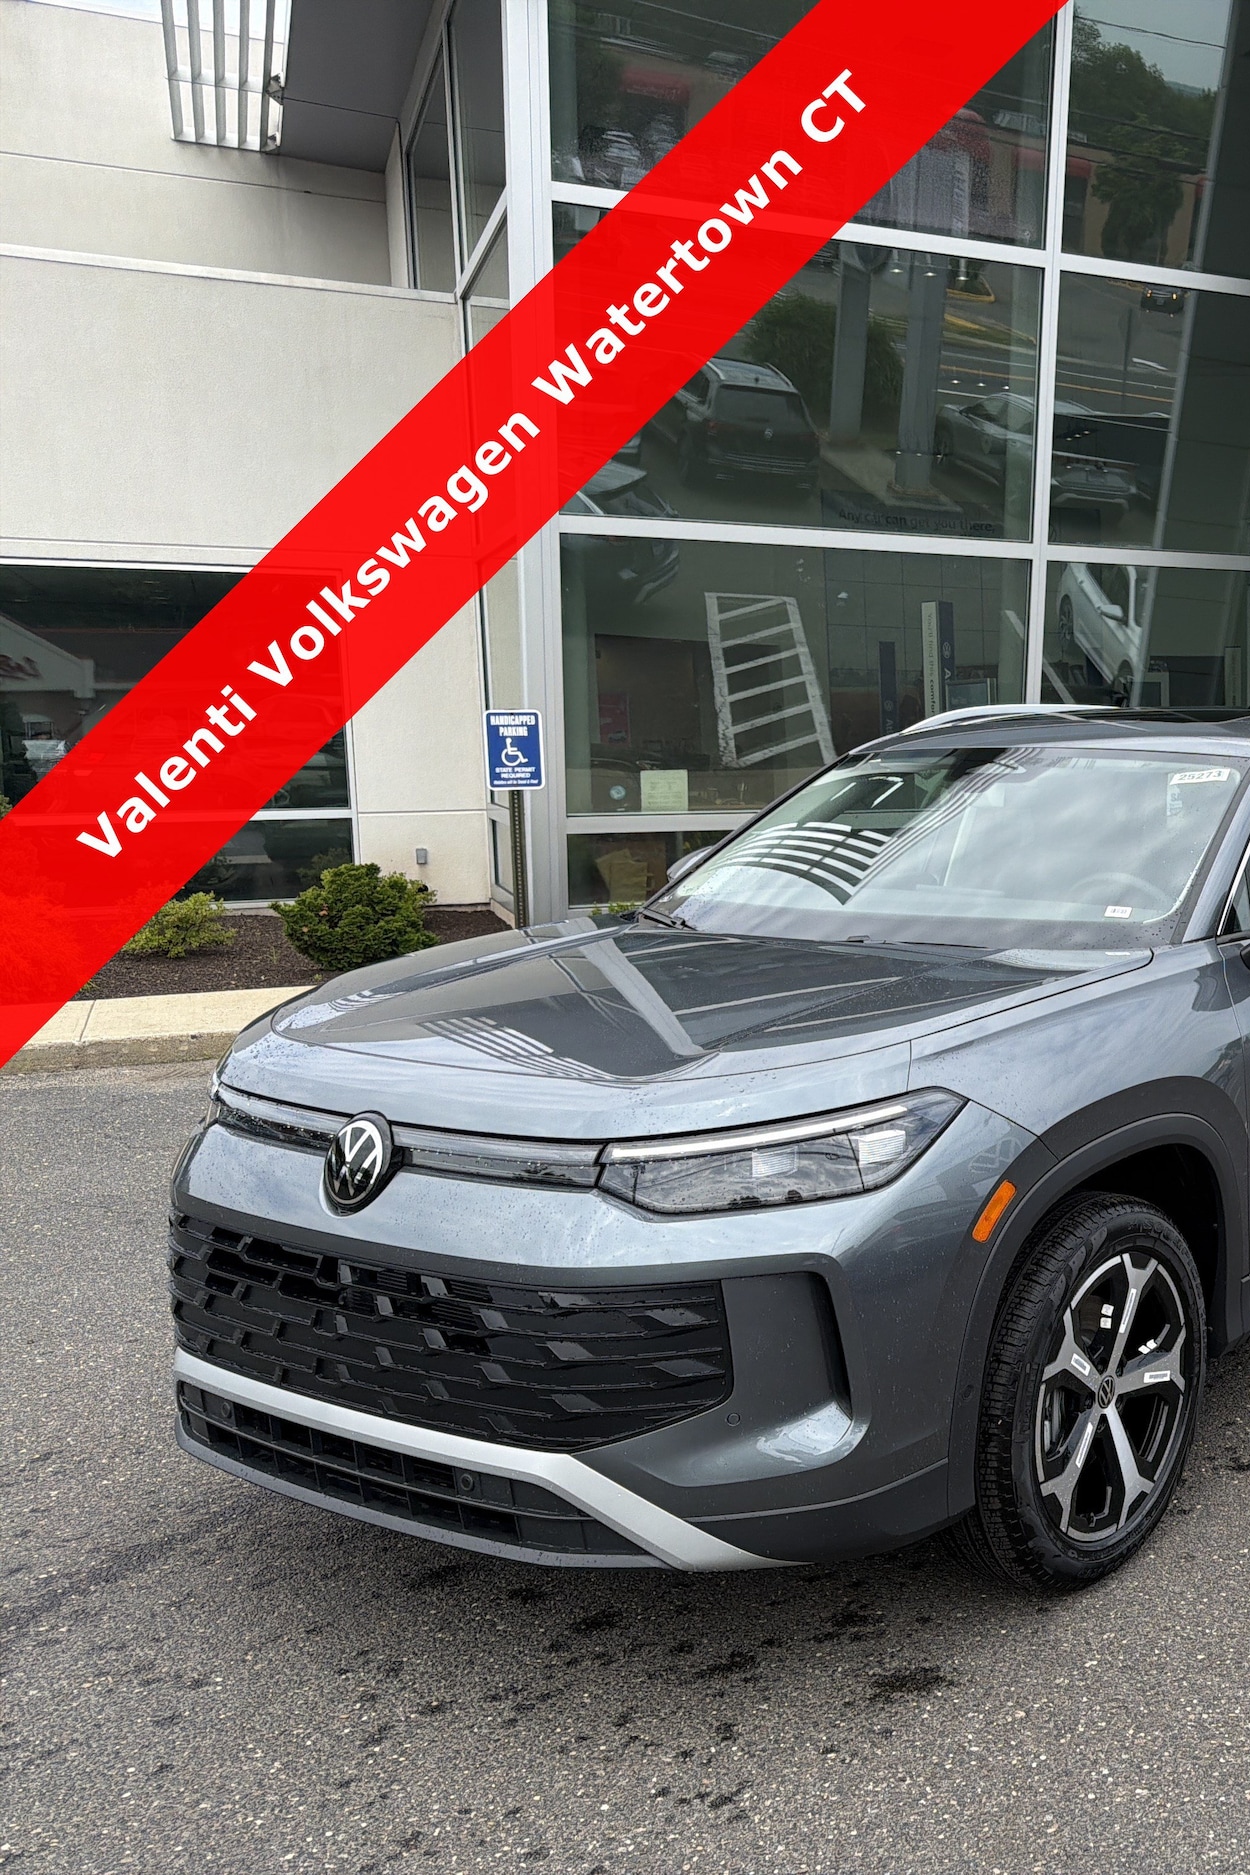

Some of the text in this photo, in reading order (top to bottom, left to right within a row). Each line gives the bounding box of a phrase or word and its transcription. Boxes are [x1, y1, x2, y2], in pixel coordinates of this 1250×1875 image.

[886, 514, 907, 527] can
[490, 714, 536, 726] HANDICAPPED
[498, 726, 529, 737] PARKING
[1178, 770, 1223, 781] 25273
